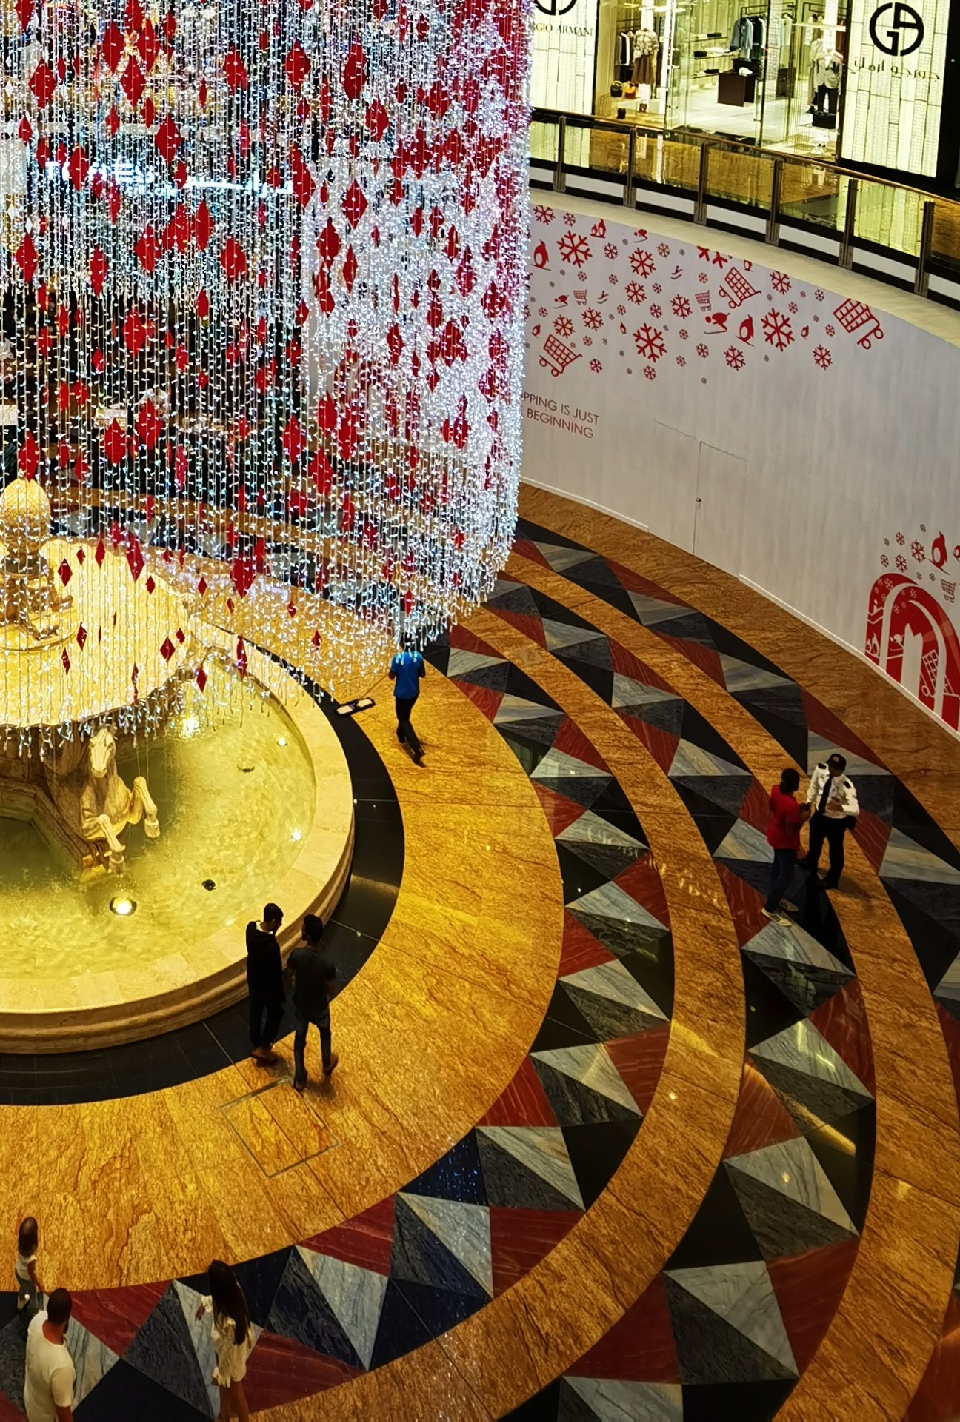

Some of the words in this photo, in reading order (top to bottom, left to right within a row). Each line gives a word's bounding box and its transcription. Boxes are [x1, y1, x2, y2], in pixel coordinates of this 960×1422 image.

[526, 407, 594, 439] BEGINNING
[560, 403, 571, 417] IS
[572, 407, 600, 426] JUST
